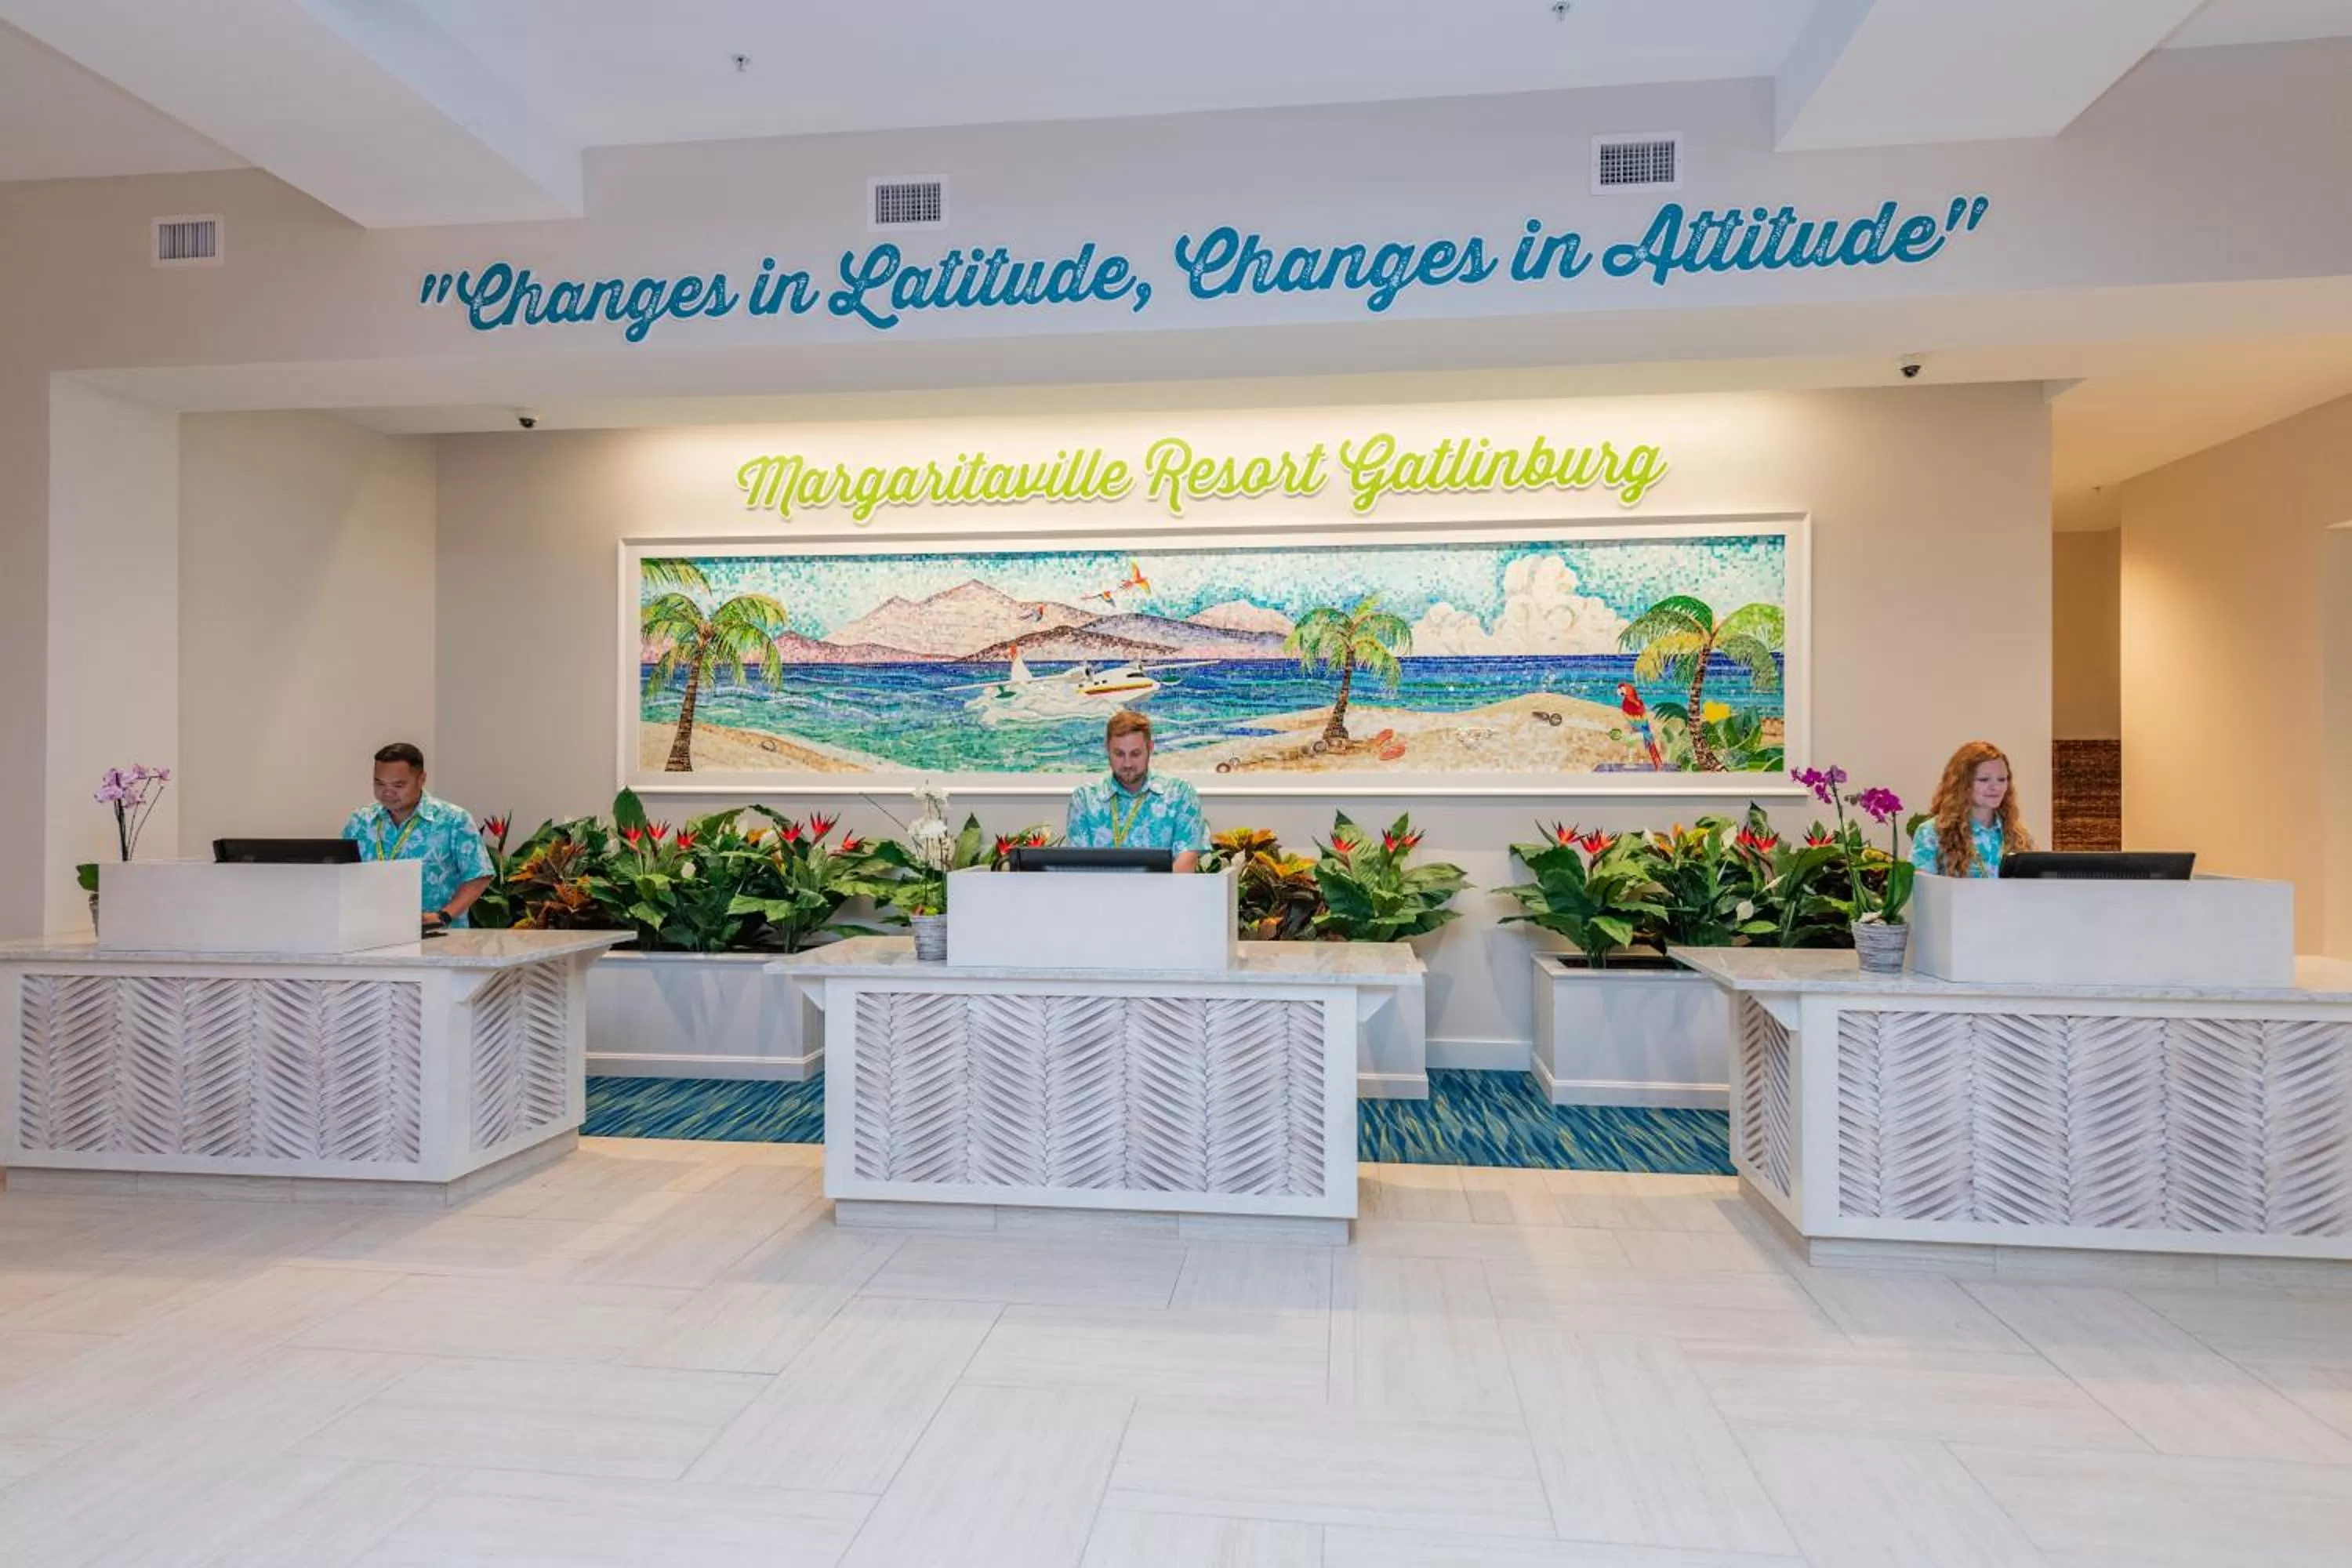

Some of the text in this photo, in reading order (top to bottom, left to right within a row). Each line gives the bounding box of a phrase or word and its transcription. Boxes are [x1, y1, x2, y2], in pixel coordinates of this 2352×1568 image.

[421, 196, 1989, 343] "Changes in Latitude, Changes in Attitude"
[736, 434, 1668, 521] Margaritaville Resort Gatlinburg
